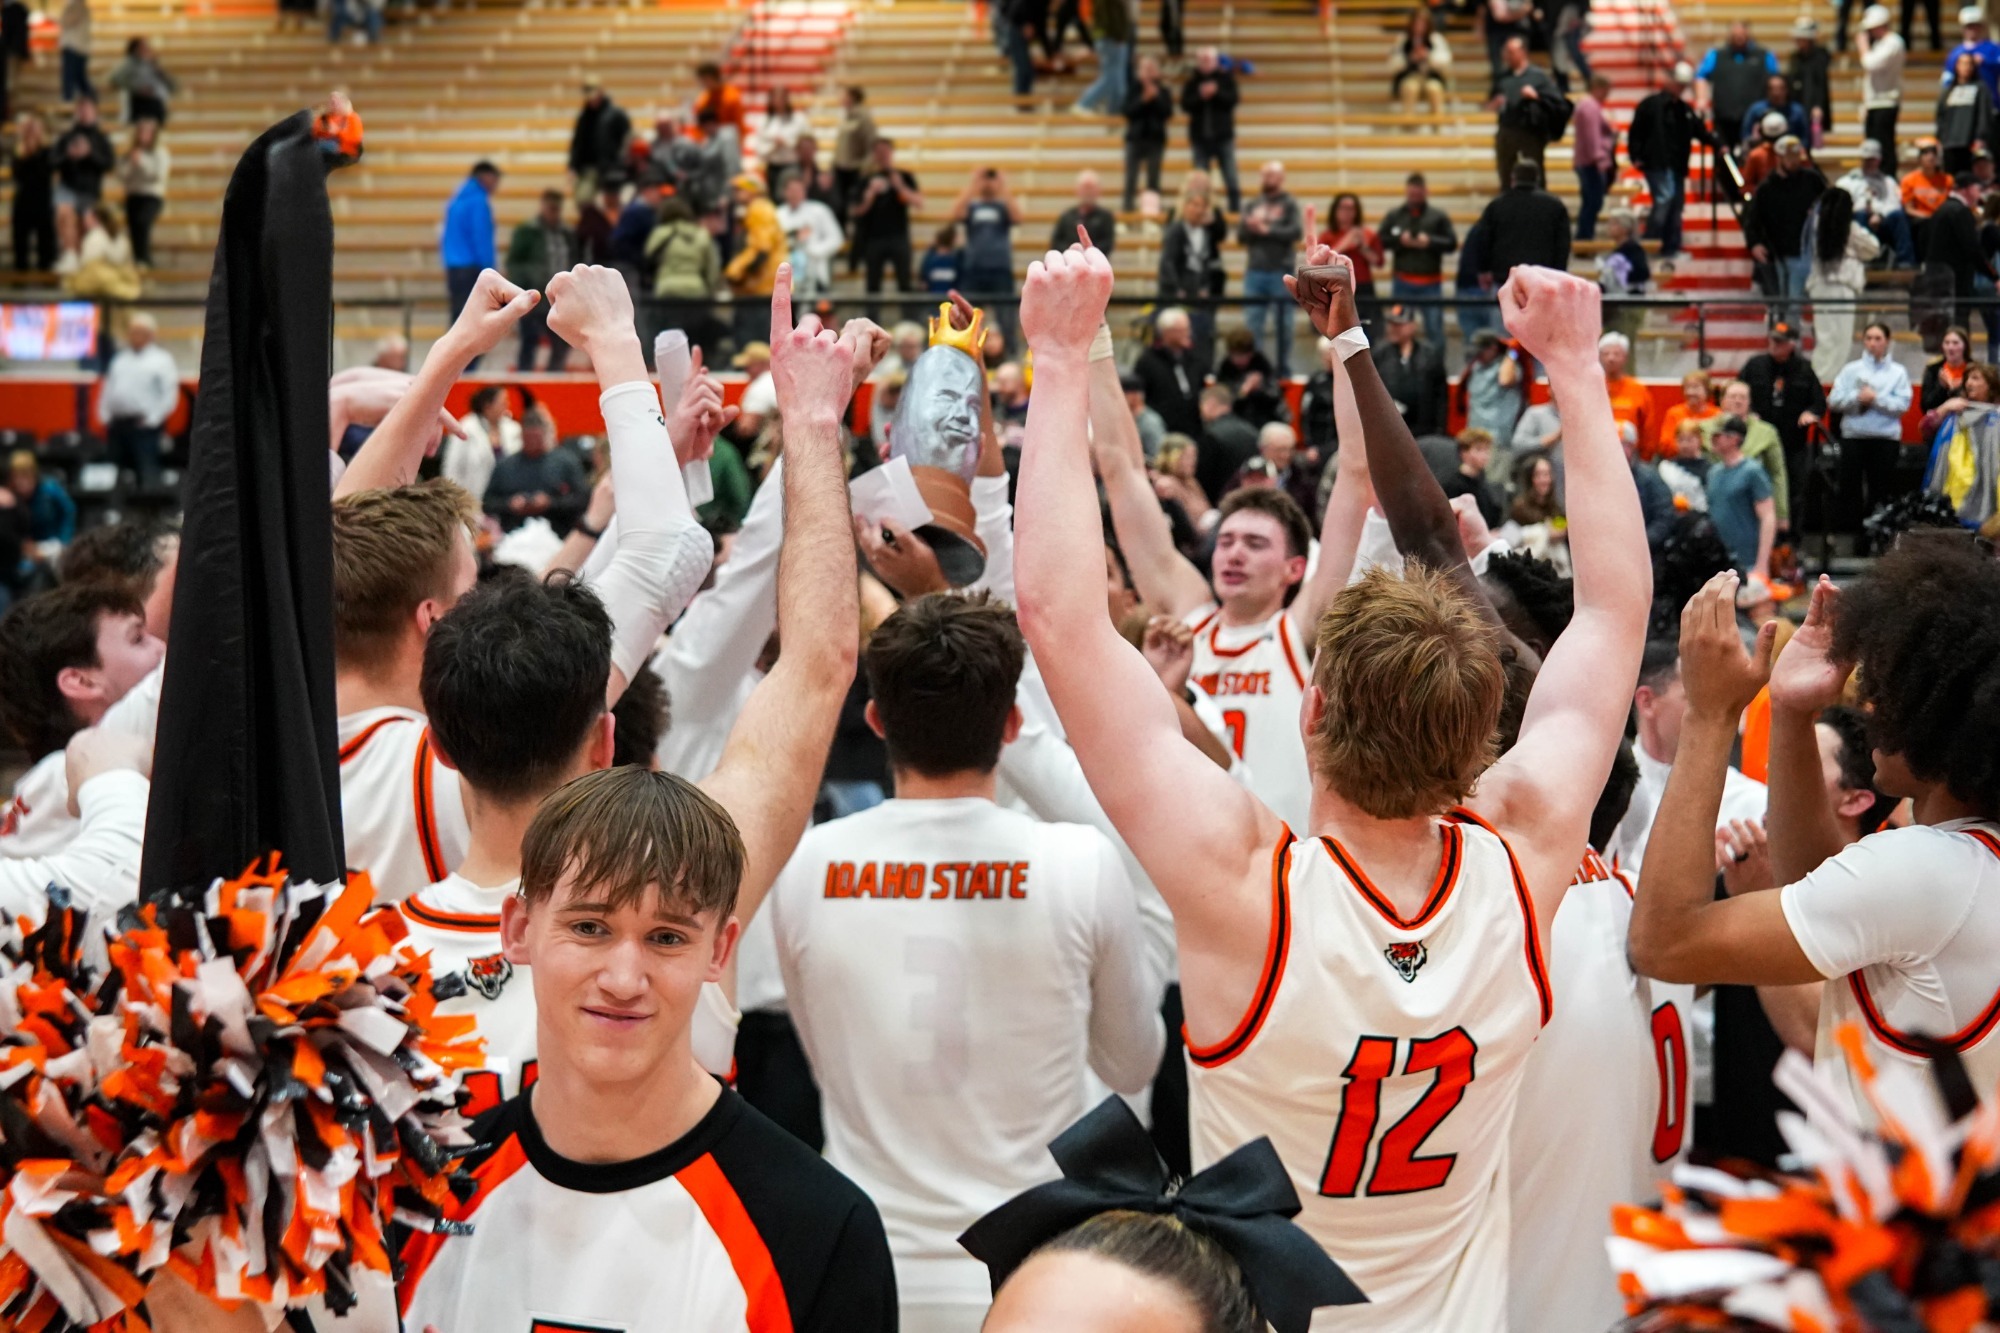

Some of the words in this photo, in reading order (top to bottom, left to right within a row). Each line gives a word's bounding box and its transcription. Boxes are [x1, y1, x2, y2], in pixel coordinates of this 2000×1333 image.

[1221, 671, 1271, 696] STATE
[823, 860, 926, 899] IDAHO
[929, 860, 1029, 899] STATE
[1317, 1024, 1479, 1198] 12
